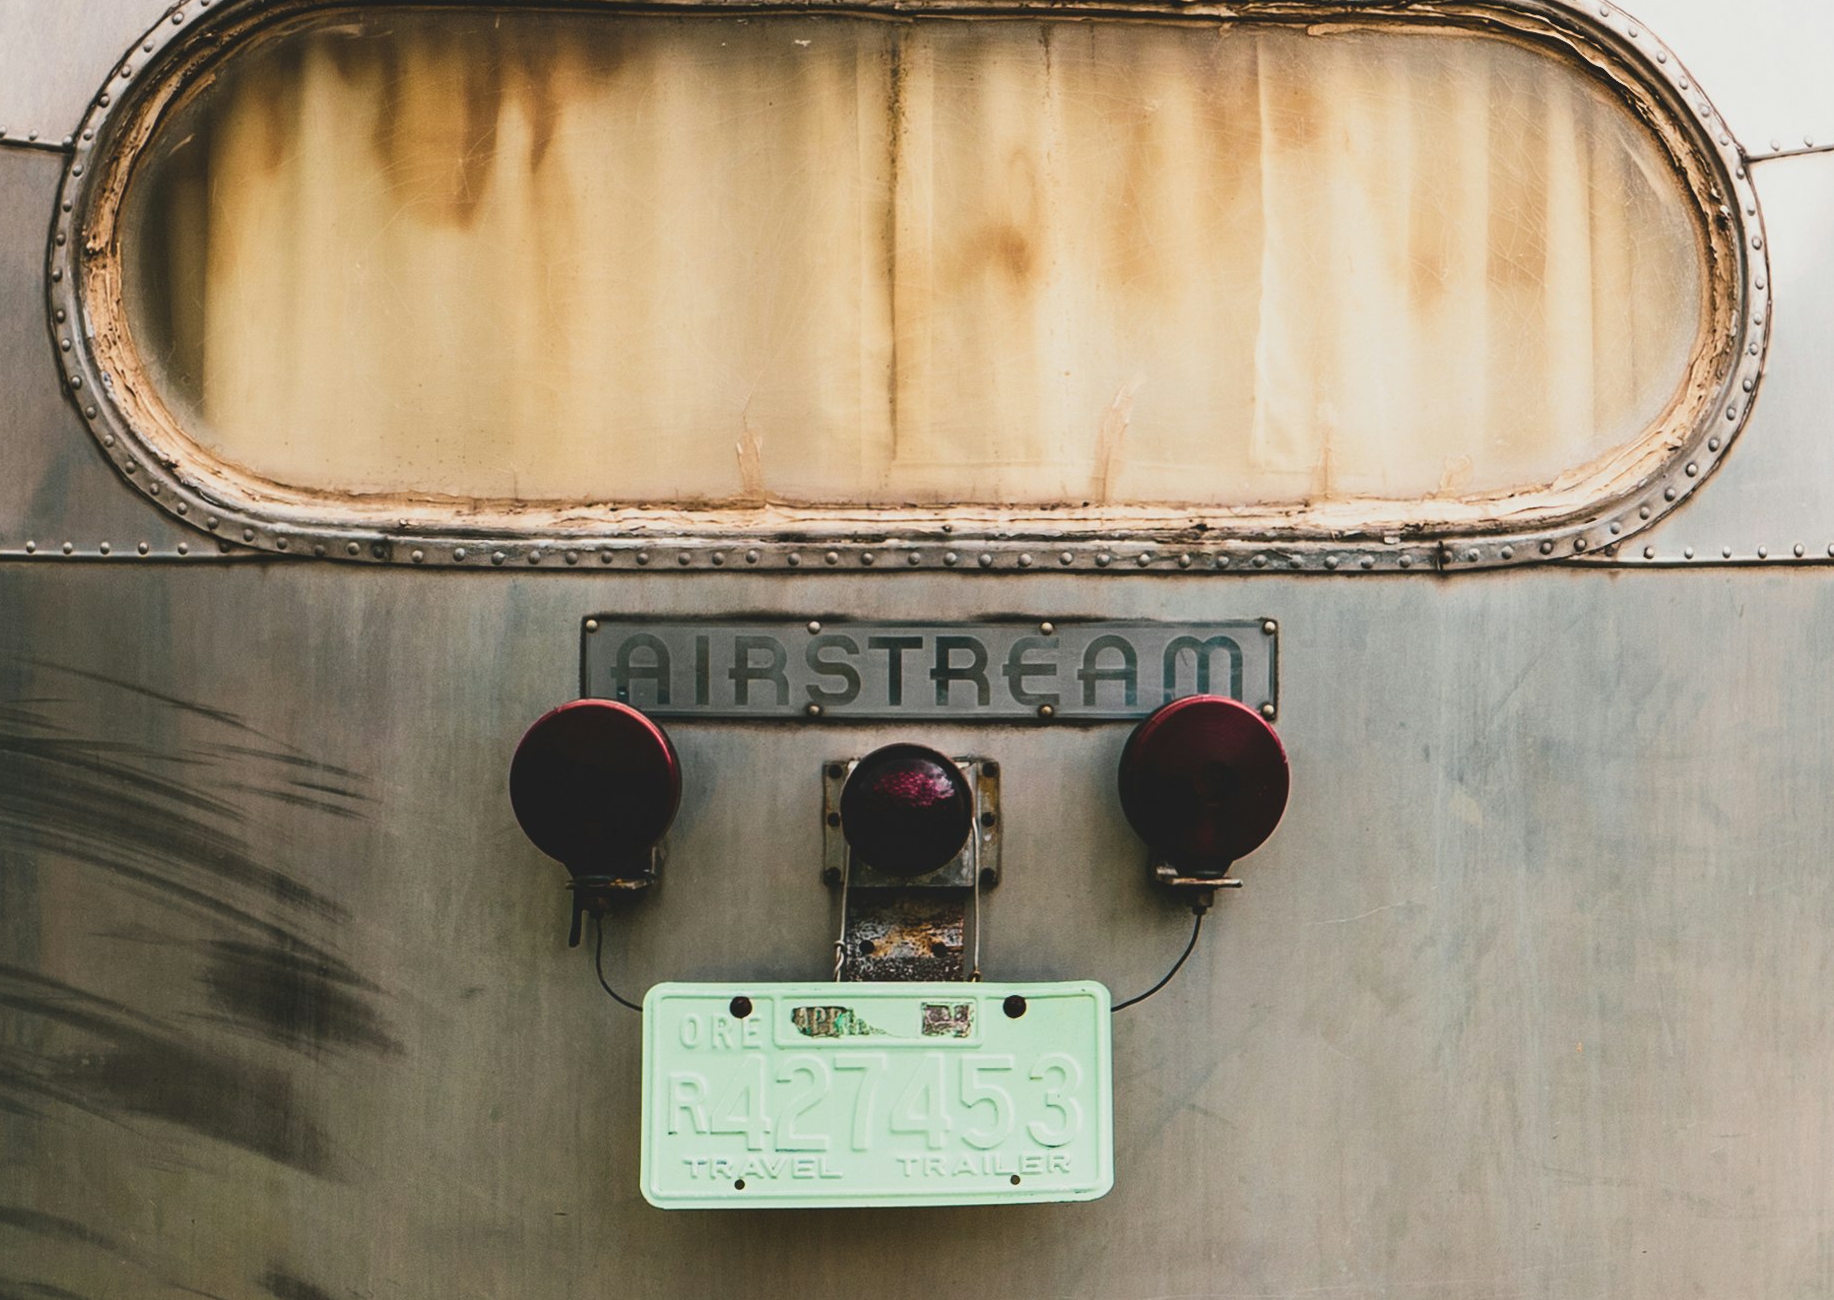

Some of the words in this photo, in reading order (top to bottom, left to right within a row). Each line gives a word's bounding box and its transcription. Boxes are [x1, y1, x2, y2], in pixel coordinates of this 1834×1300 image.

[610, 633, 1244, 706] AIRSTREAM
[679, 1012, 764, 1050] ORE
[668, 1052, 1084, 1153] R427453
[681, 1155, 844, 1180] TRAVEL
[896, 1152, 1072, 1177] TRAILER
